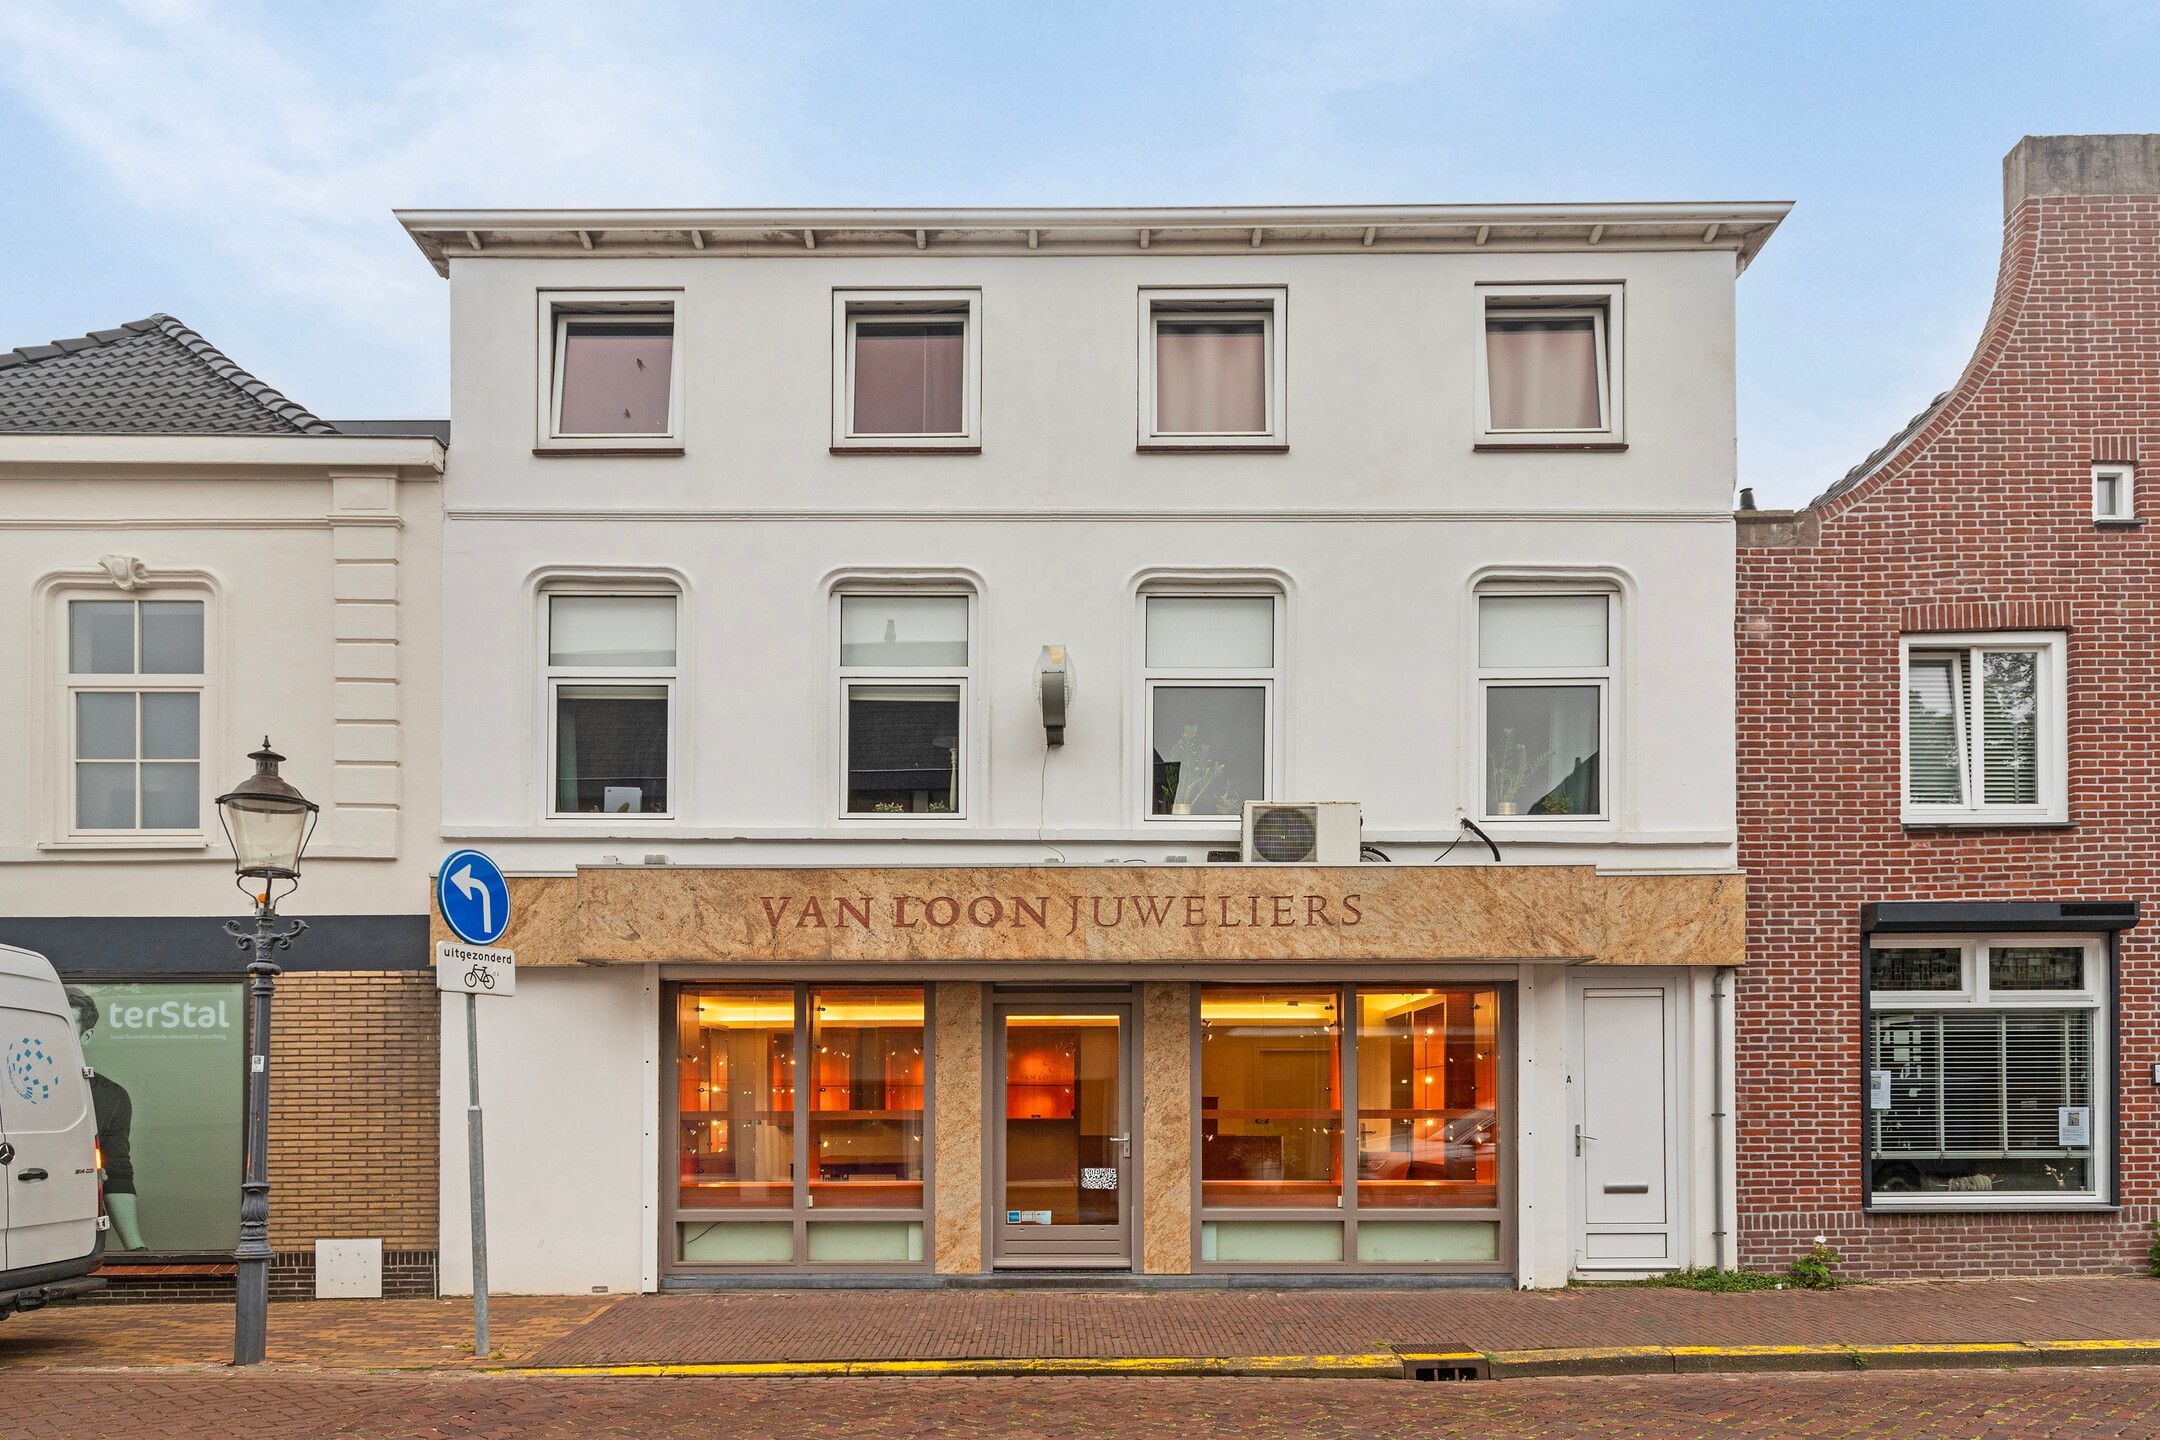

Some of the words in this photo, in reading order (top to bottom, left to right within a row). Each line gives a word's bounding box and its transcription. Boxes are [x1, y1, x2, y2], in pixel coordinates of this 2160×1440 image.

[760, 896, 874, 928] VAN
[893, 896, 1050, 928] LOON
[1066, 894, 1362, 936] JUWELIERS
[444, 948, 512, 964] uitgezonderd
[109, 1000, 230, 1028] terStal
[1566, 1075, 1572, 1083] A
